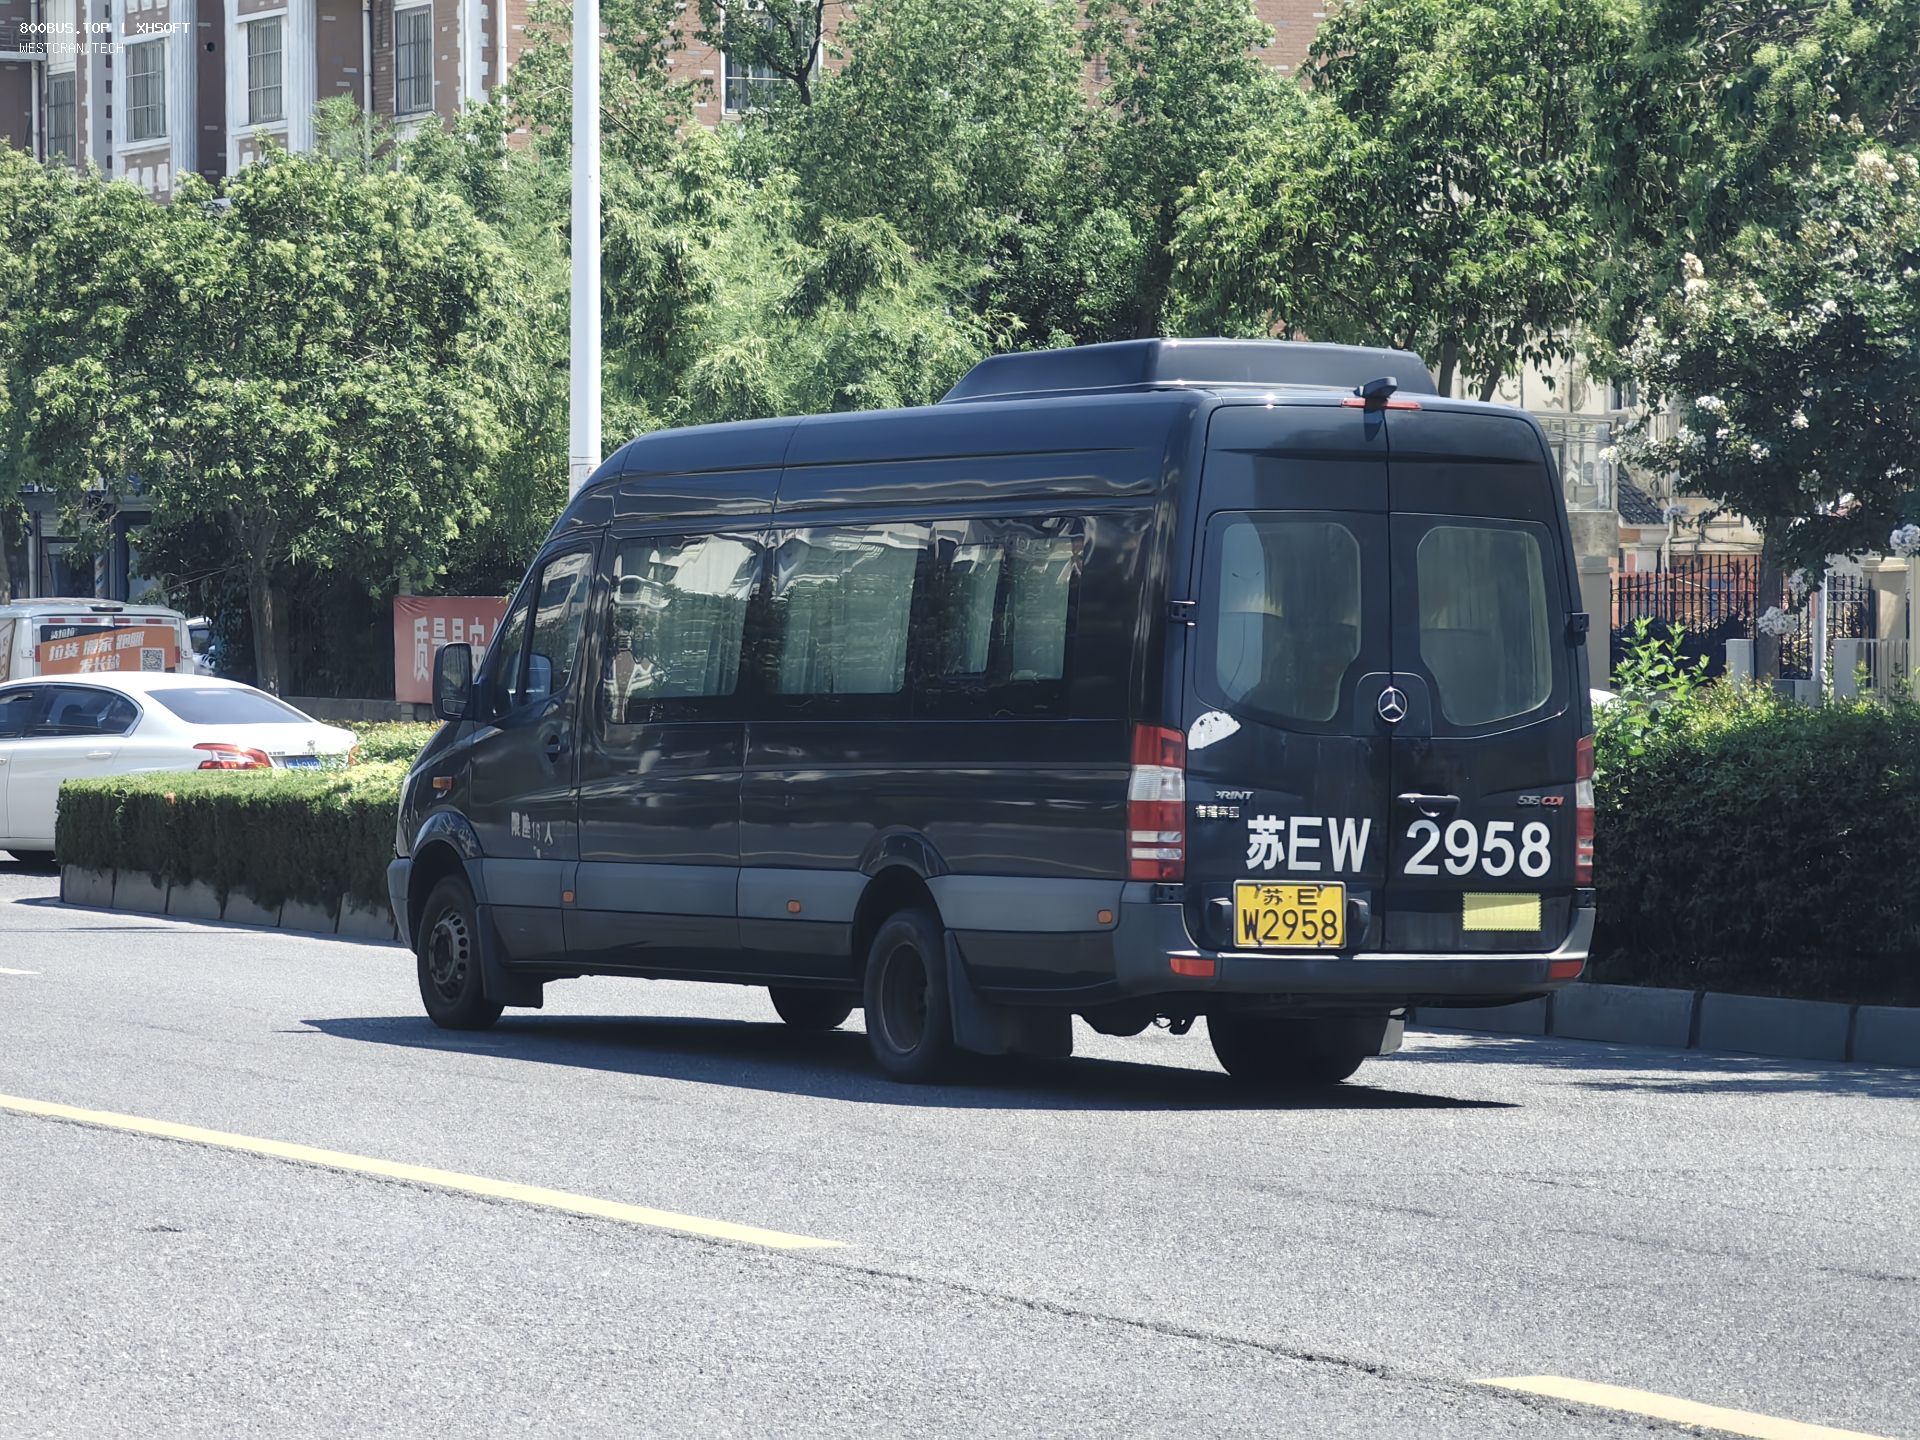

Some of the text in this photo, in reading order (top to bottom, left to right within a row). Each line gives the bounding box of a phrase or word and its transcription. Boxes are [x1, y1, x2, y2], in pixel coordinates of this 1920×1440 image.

[48, 642, 80, 662] 拉货
[83, 636, 114, 656] 搬家
[1245, 814, 1552, 878] 苏EW 2958
[1242, 908, 1338, 941] W2958
